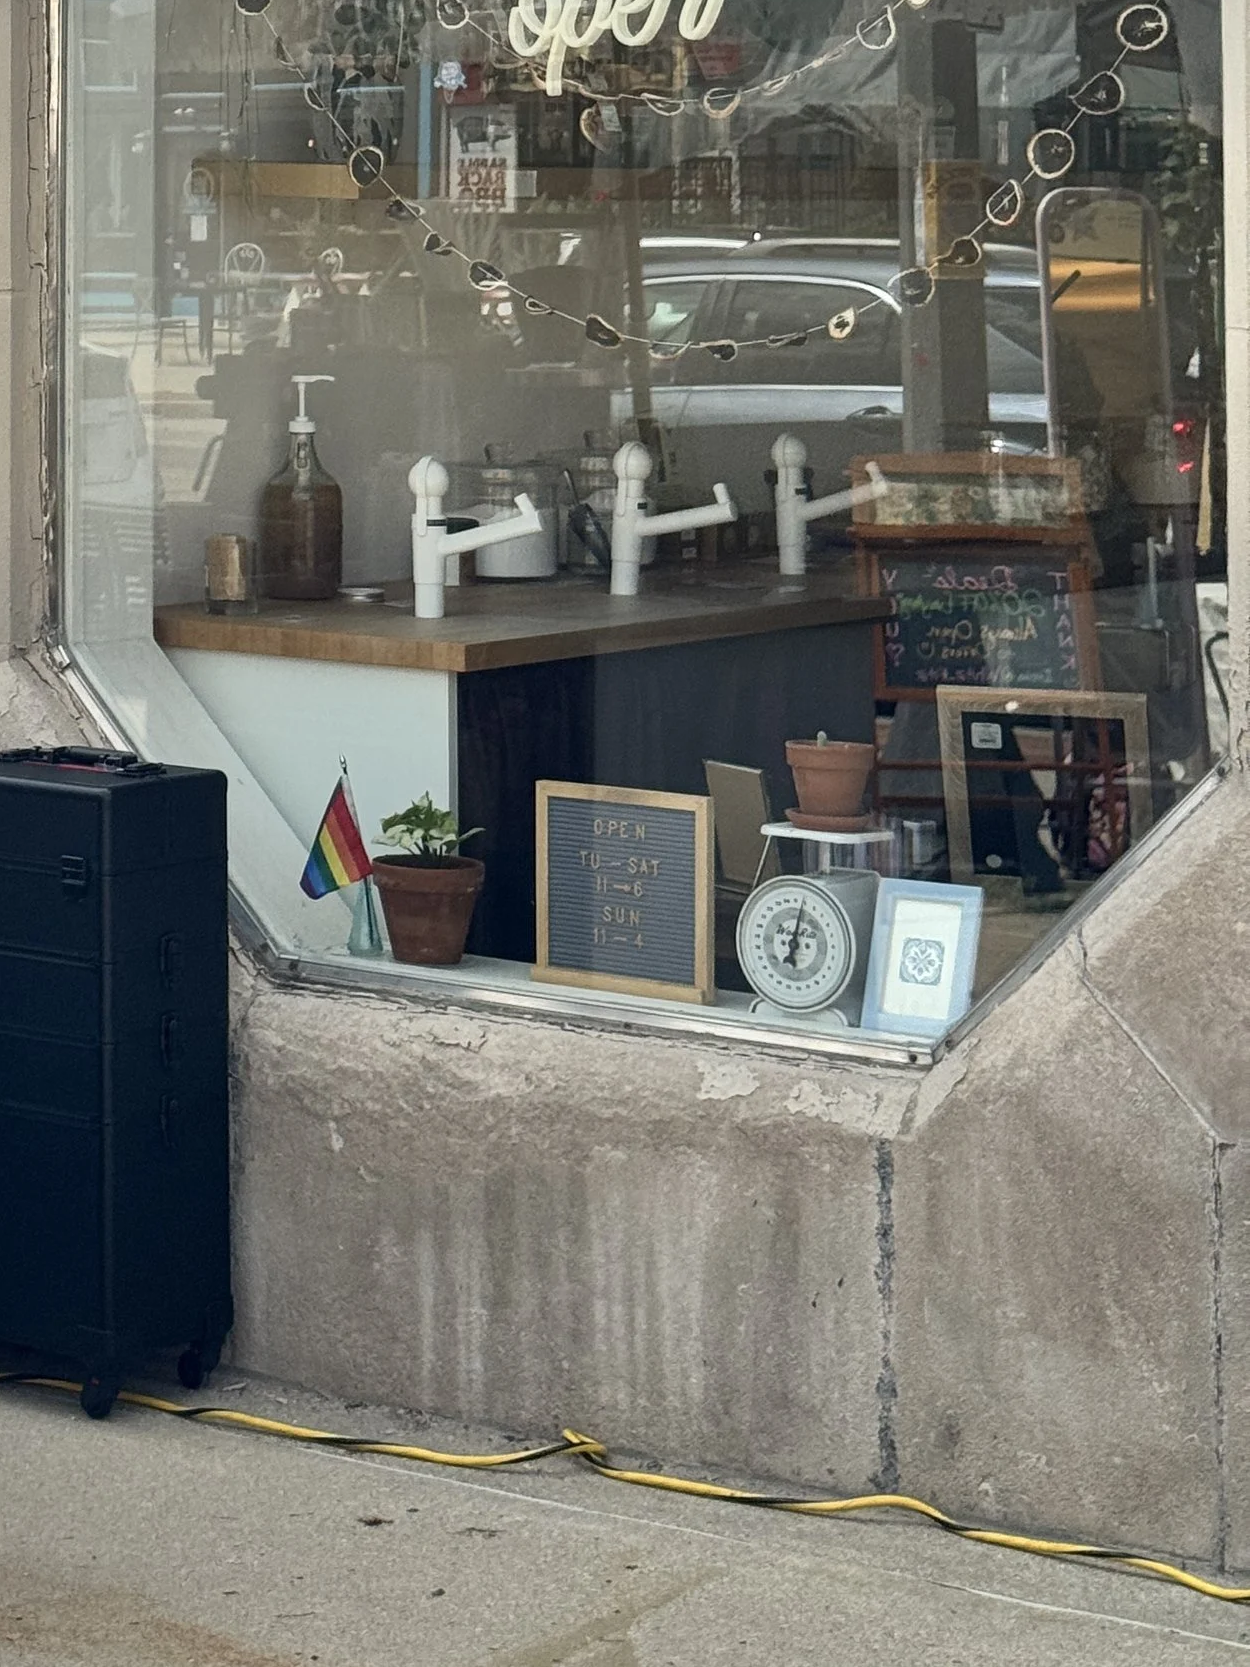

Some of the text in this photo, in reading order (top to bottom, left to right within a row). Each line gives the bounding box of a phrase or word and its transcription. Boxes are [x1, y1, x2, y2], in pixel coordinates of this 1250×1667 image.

[593, 819, 646, 841] OPEN
[627, 857, 660, 876] SAT
[602, 906, 640, 927] SUN
